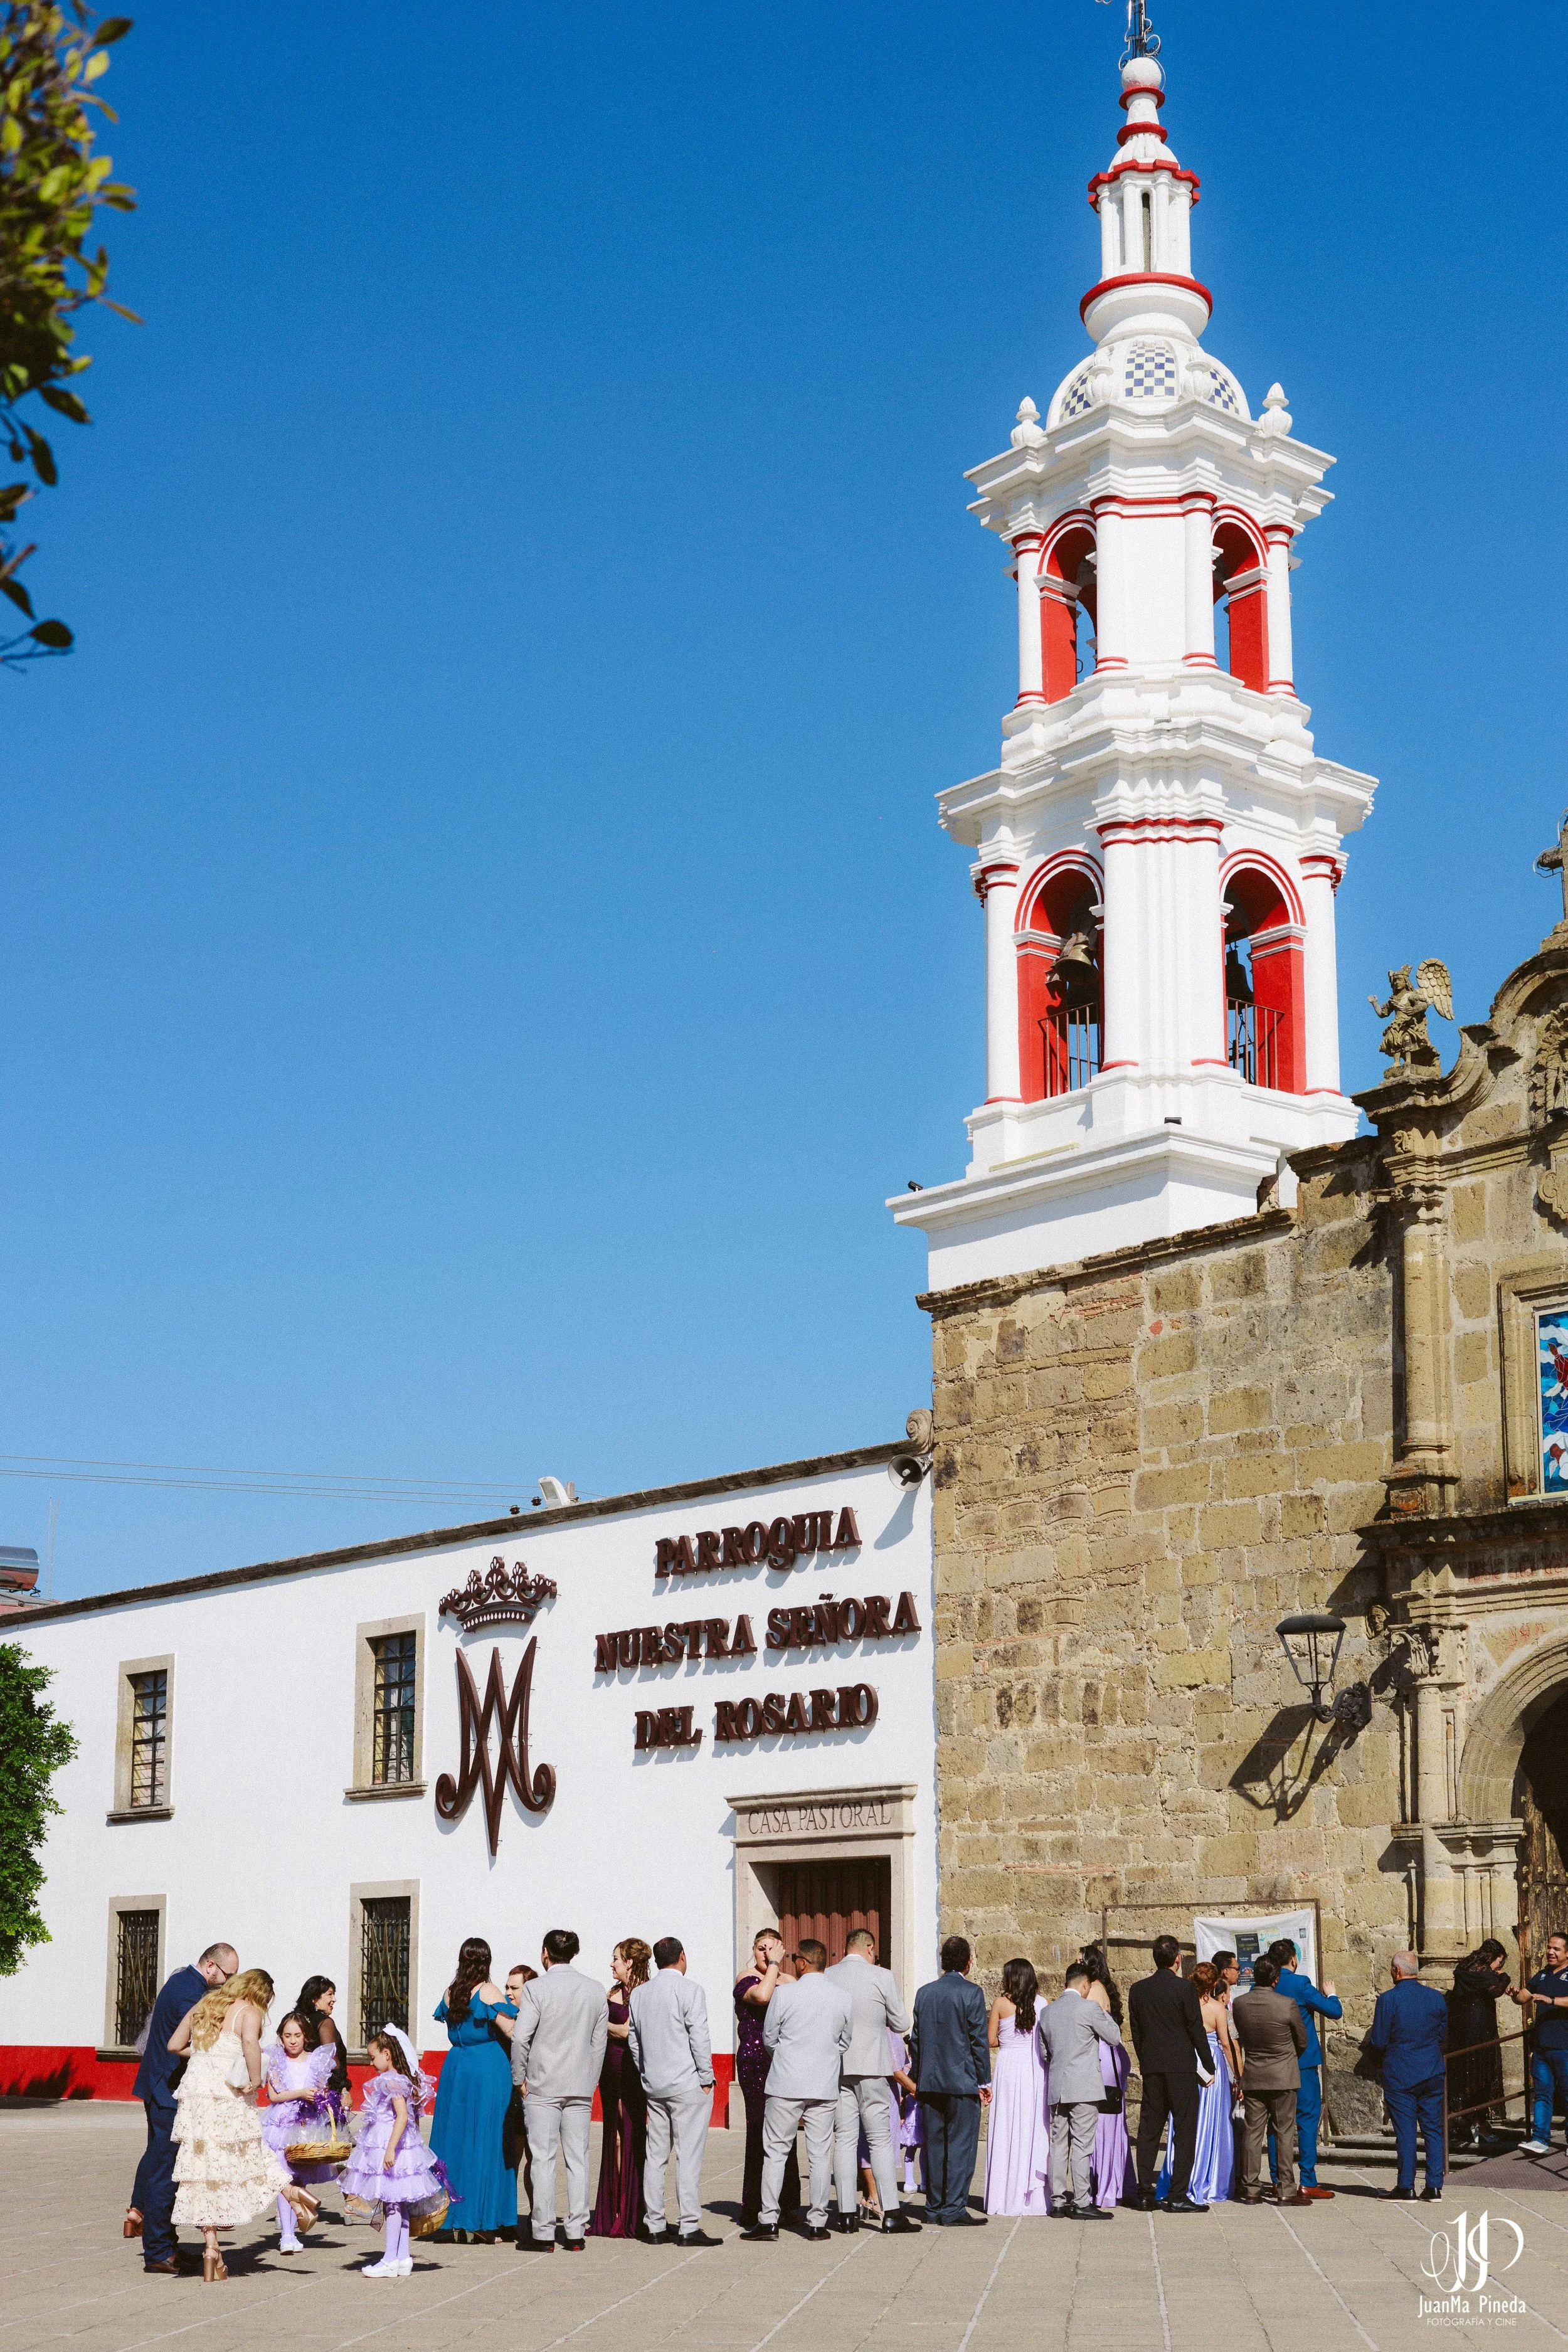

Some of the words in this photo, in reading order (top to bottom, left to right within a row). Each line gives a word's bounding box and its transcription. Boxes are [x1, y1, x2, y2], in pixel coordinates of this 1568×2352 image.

[655, 1507, 862, 1578] PARROQUIA
[595, 1614, 758, 1672] NUESTRA
[766, 1591, 922, 1650] SEÑORA
[634, 1706, 703, 1750] DEL
[714, 1683, 878, 1741] ROSARIO
[748, 1808, 792, 1834] CASA
[797, 1799, 891, 1831] PASTORAL
